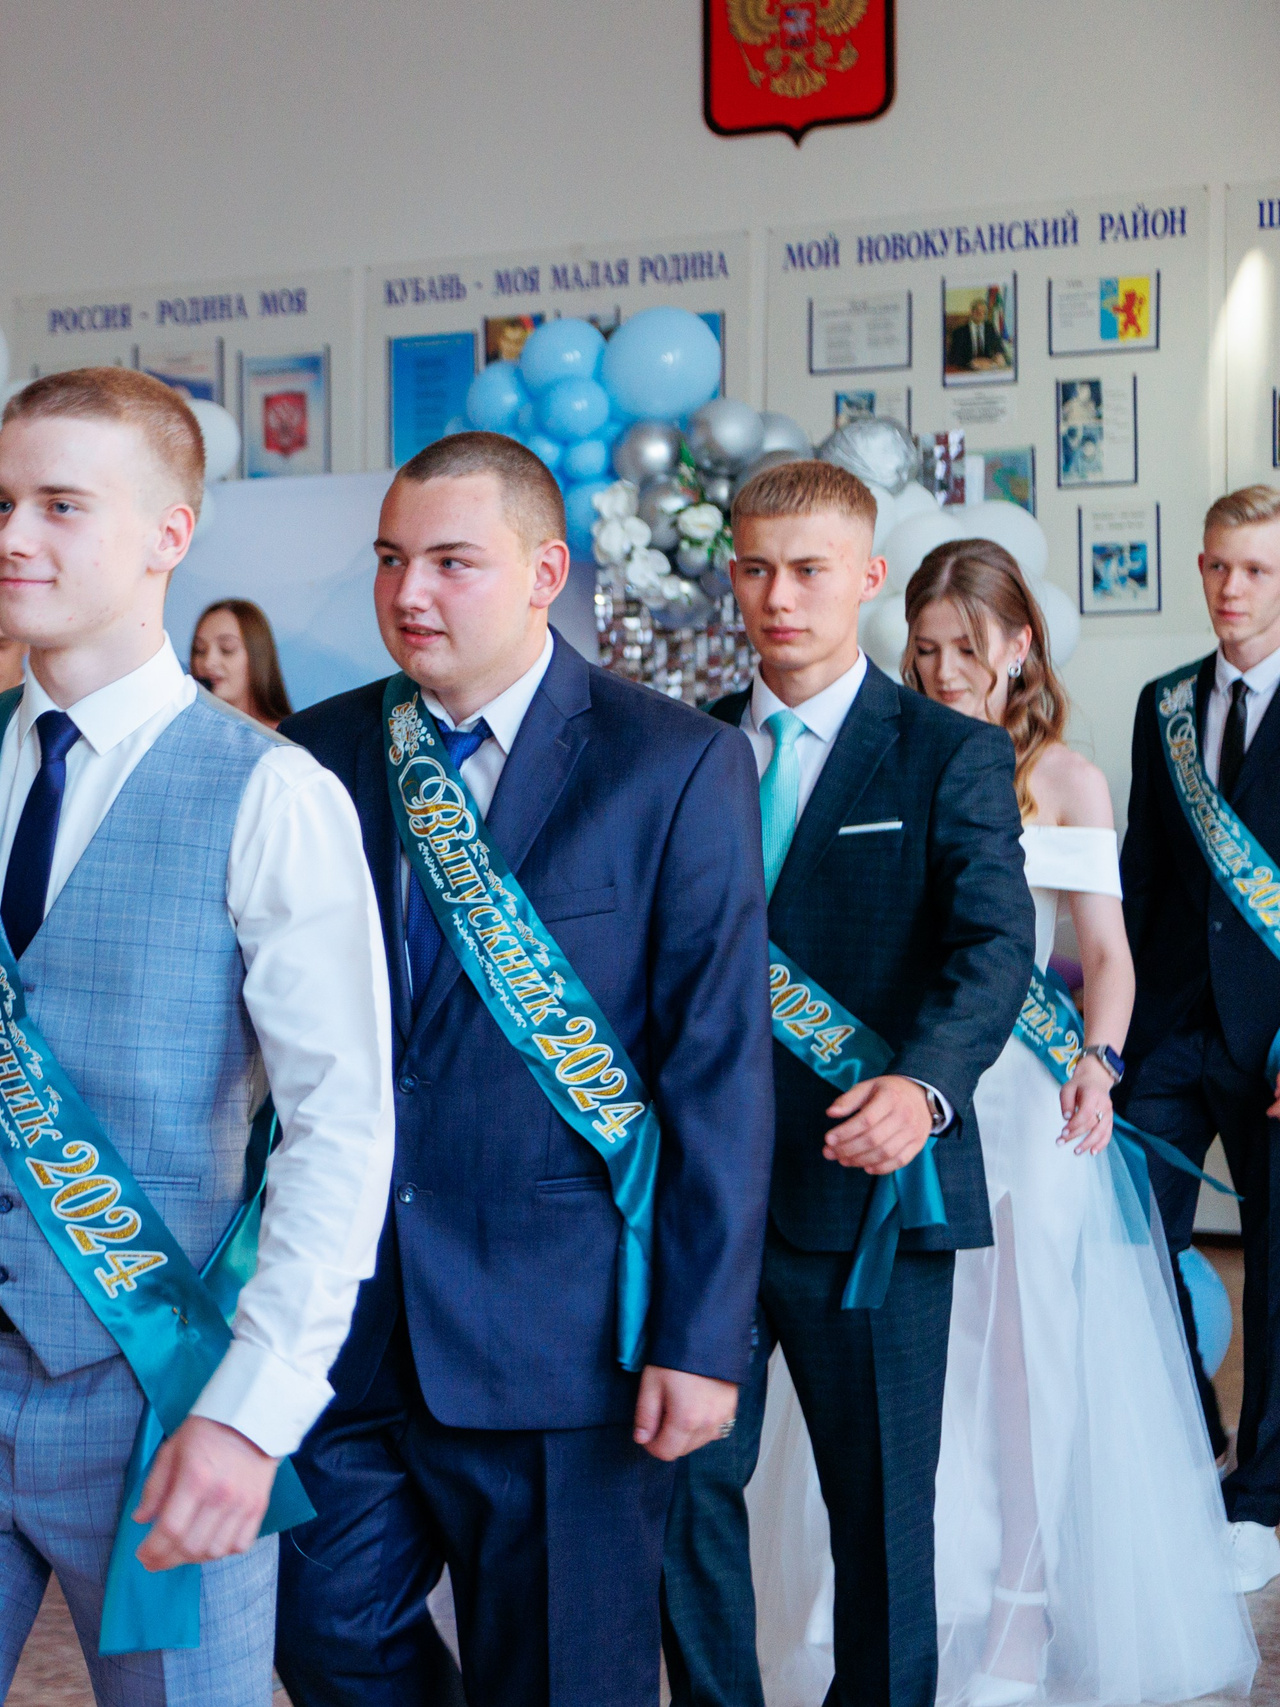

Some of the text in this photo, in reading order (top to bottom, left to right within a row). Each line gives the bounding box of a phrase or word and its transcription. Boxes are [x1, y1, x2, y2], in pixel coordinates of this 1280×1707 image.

[782, 203, 1188, 272] МОЙ НОВОКУБАНСКИЙ РАЙОН
[48, 303, 132, 334] РОССИЯ
[156, 293, 249, 327] РОДИНА
[258, 287, 308, 318] МОЯ
[383, 273, 468, 306] КУБАНЬ
[493, 265, 541, 297] МОЯ
[550, 258, 630, 291] МАЛАЯ
[639, 250, 730, 286] РОДИНА
[532, 1015, 645, 1143] 2024
[24, 1139, 168, 1300] 2024
